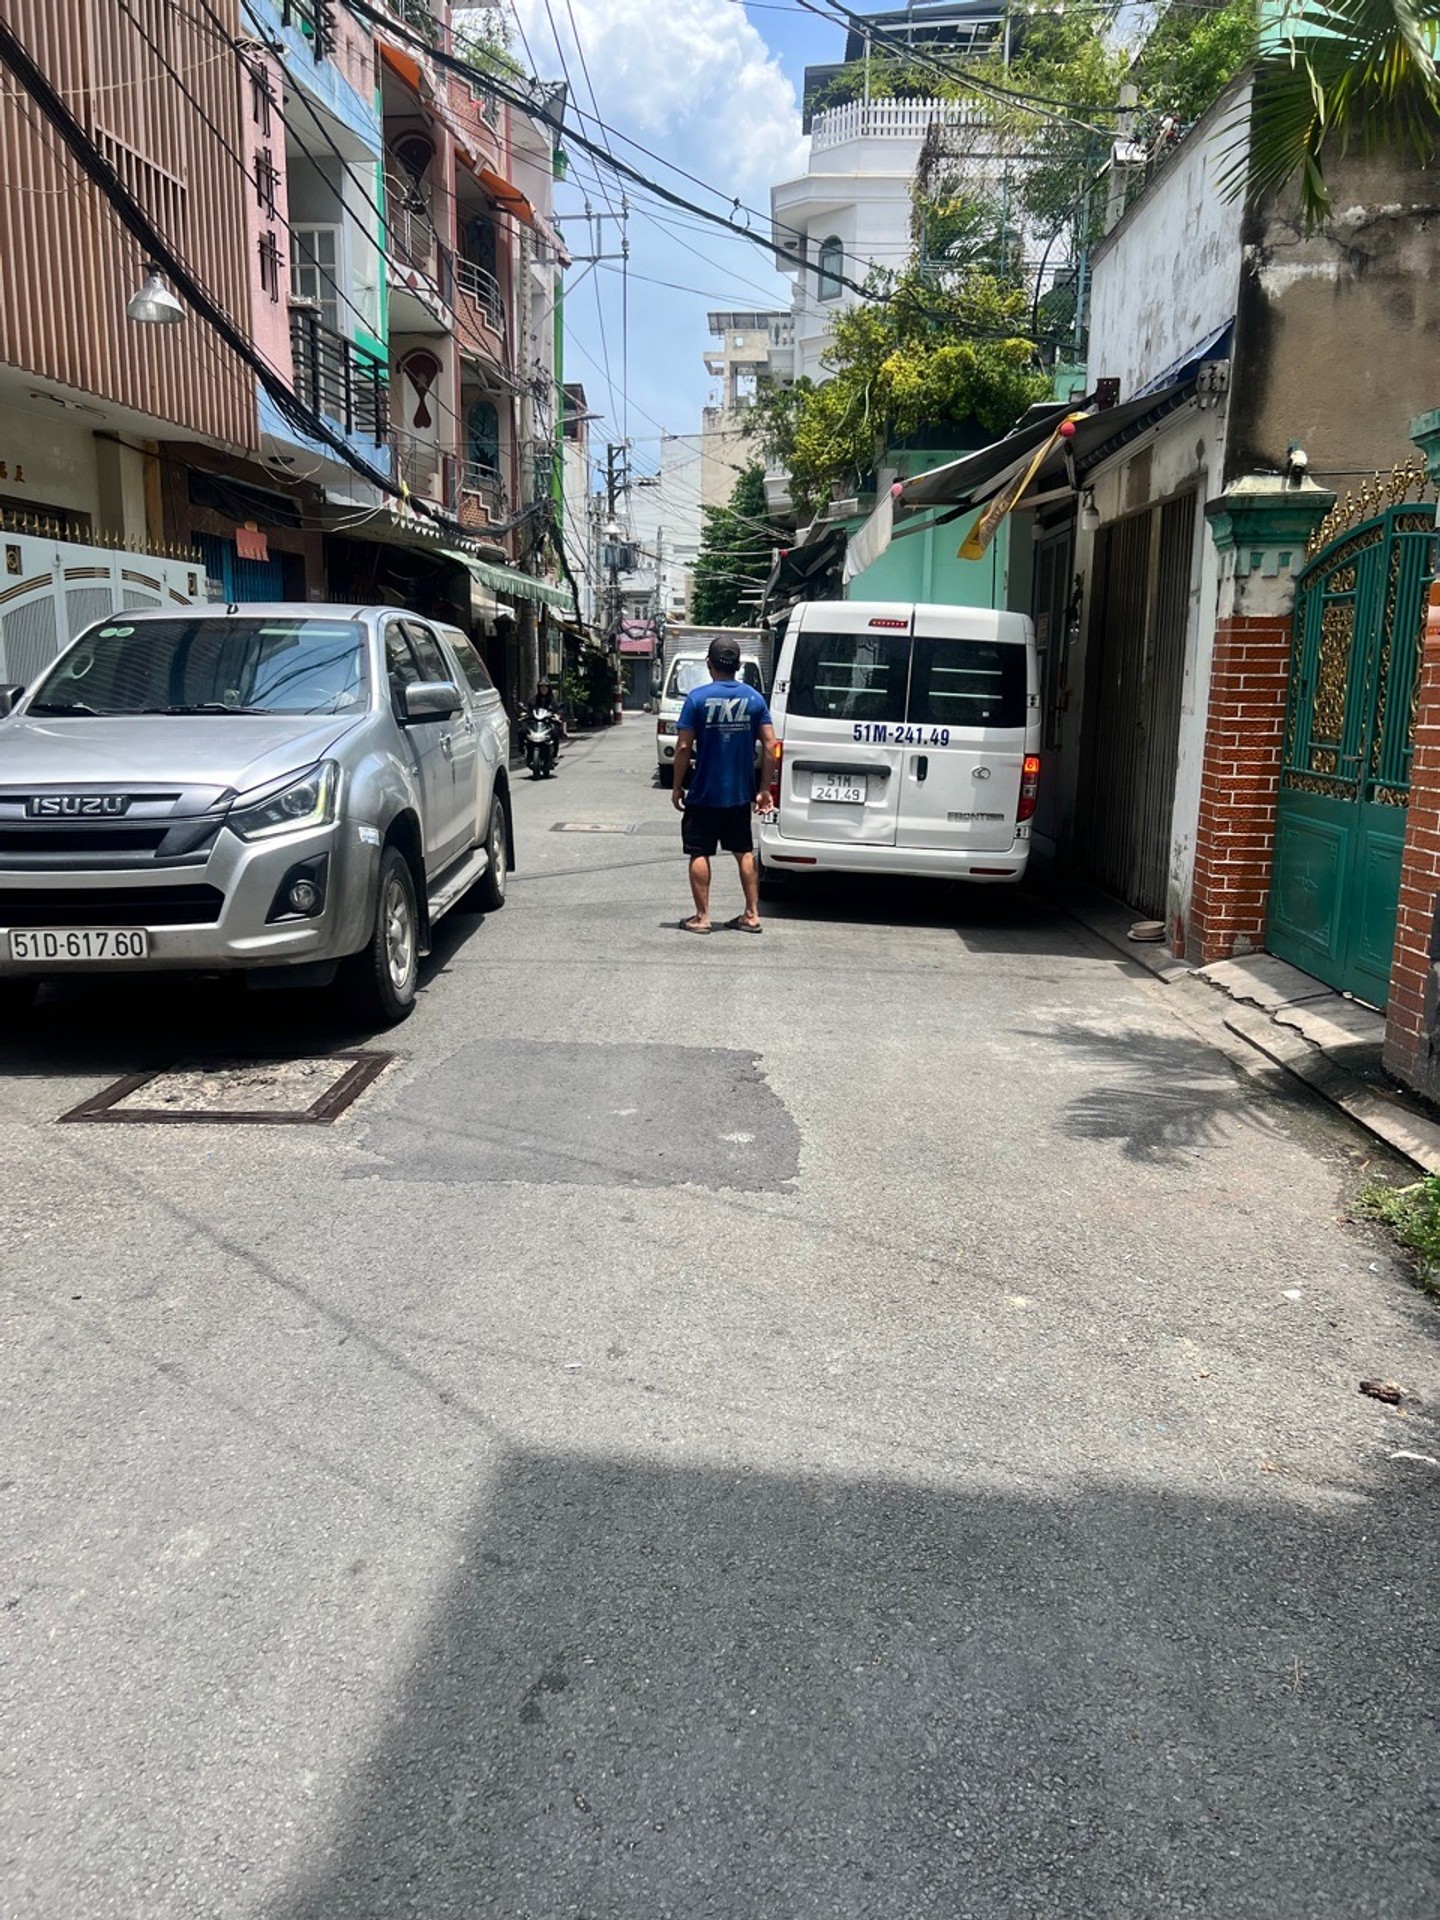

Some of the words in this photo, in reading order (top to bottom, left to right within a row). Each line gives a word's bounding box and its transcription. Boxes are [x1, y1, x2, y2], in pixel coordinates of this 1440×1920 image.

[705, 697, 751, 723] TKL
[853, 724, 950, 747] 51M-241.49
[827, 775, 851, 787] 51M
[816, 787, 860, 801] 241.49
[32, 797, 123, 814] ISUZU
[14, 932, 144, 958] 51D-617.60
